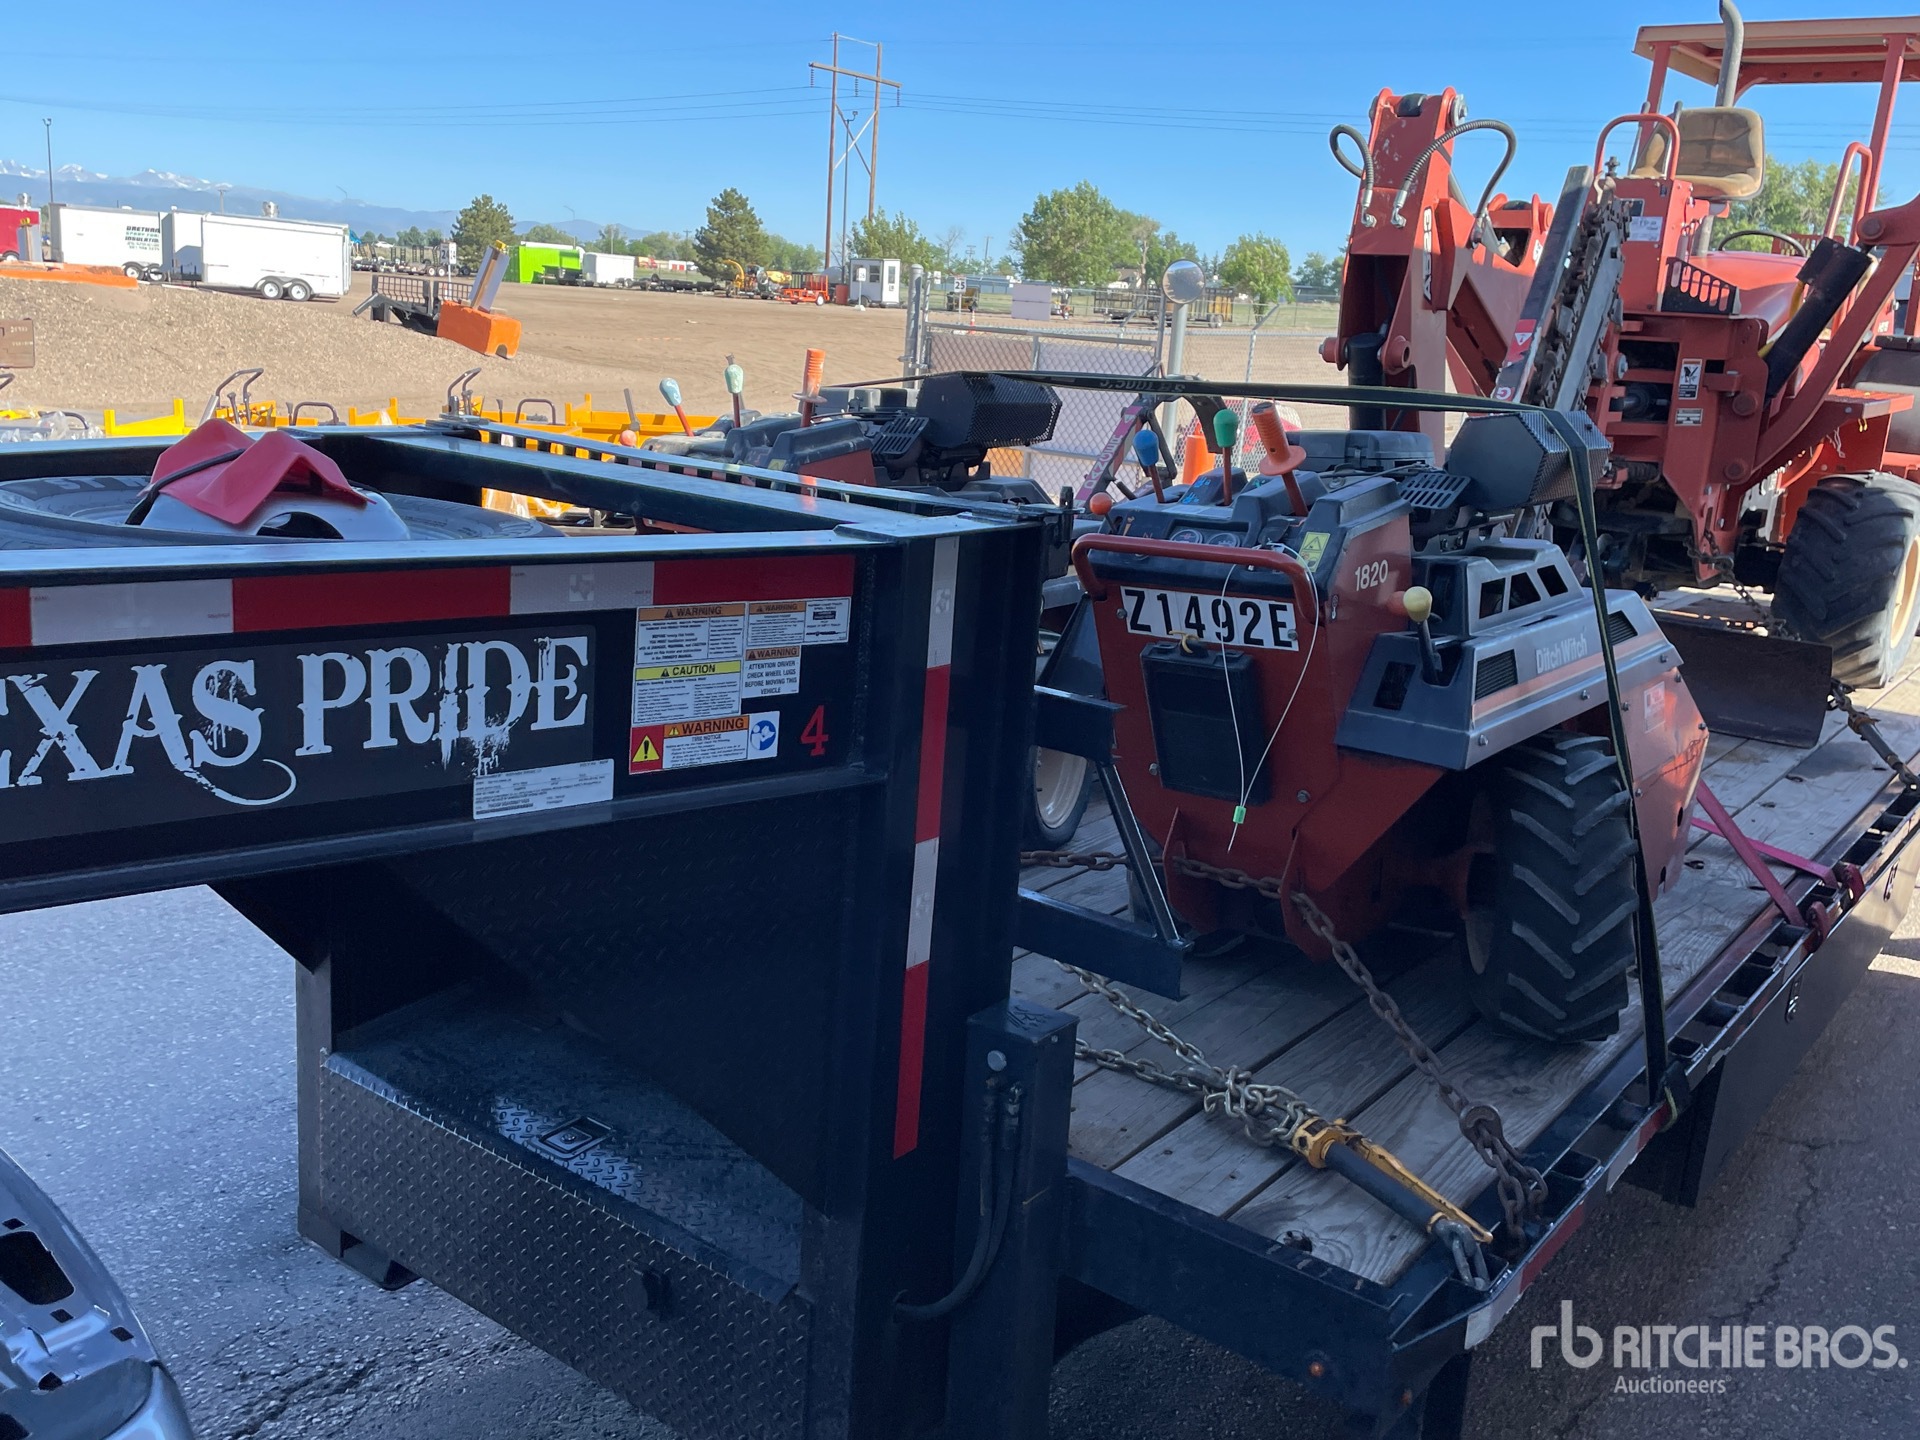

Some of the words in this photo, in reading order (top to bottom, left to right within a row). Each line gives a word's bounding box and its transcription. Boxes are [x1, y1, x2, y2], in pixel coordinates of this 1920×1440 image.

[955, 281, 965, 290] 25
[1083, 434, 1124, 489] DANGER
[1355, 559, 1389, 591] 1820
[676, 606, 722, 617] WARNING
[765, 603, 798, 611] WARNING
[1125, 588, 1293, 648] Z1492E
[757, 647, 797, 658] WARNING
[672, 664, 716, 676] CAUTION
[749, 662, 776, 670] ATTENTION
[746, 671, 764, 679] CHECK
[765, 669, 781, 677] WHEEL
[744, 680, 764, 688] BEFORE
[765, 678, 785, 686] MOVING
[0, 659, 297, 805] XAS
[295, 636, 588, 757] PRIDE
[682, 717, 744, 734] WARNING
[800, 705, 829, 756] 4
